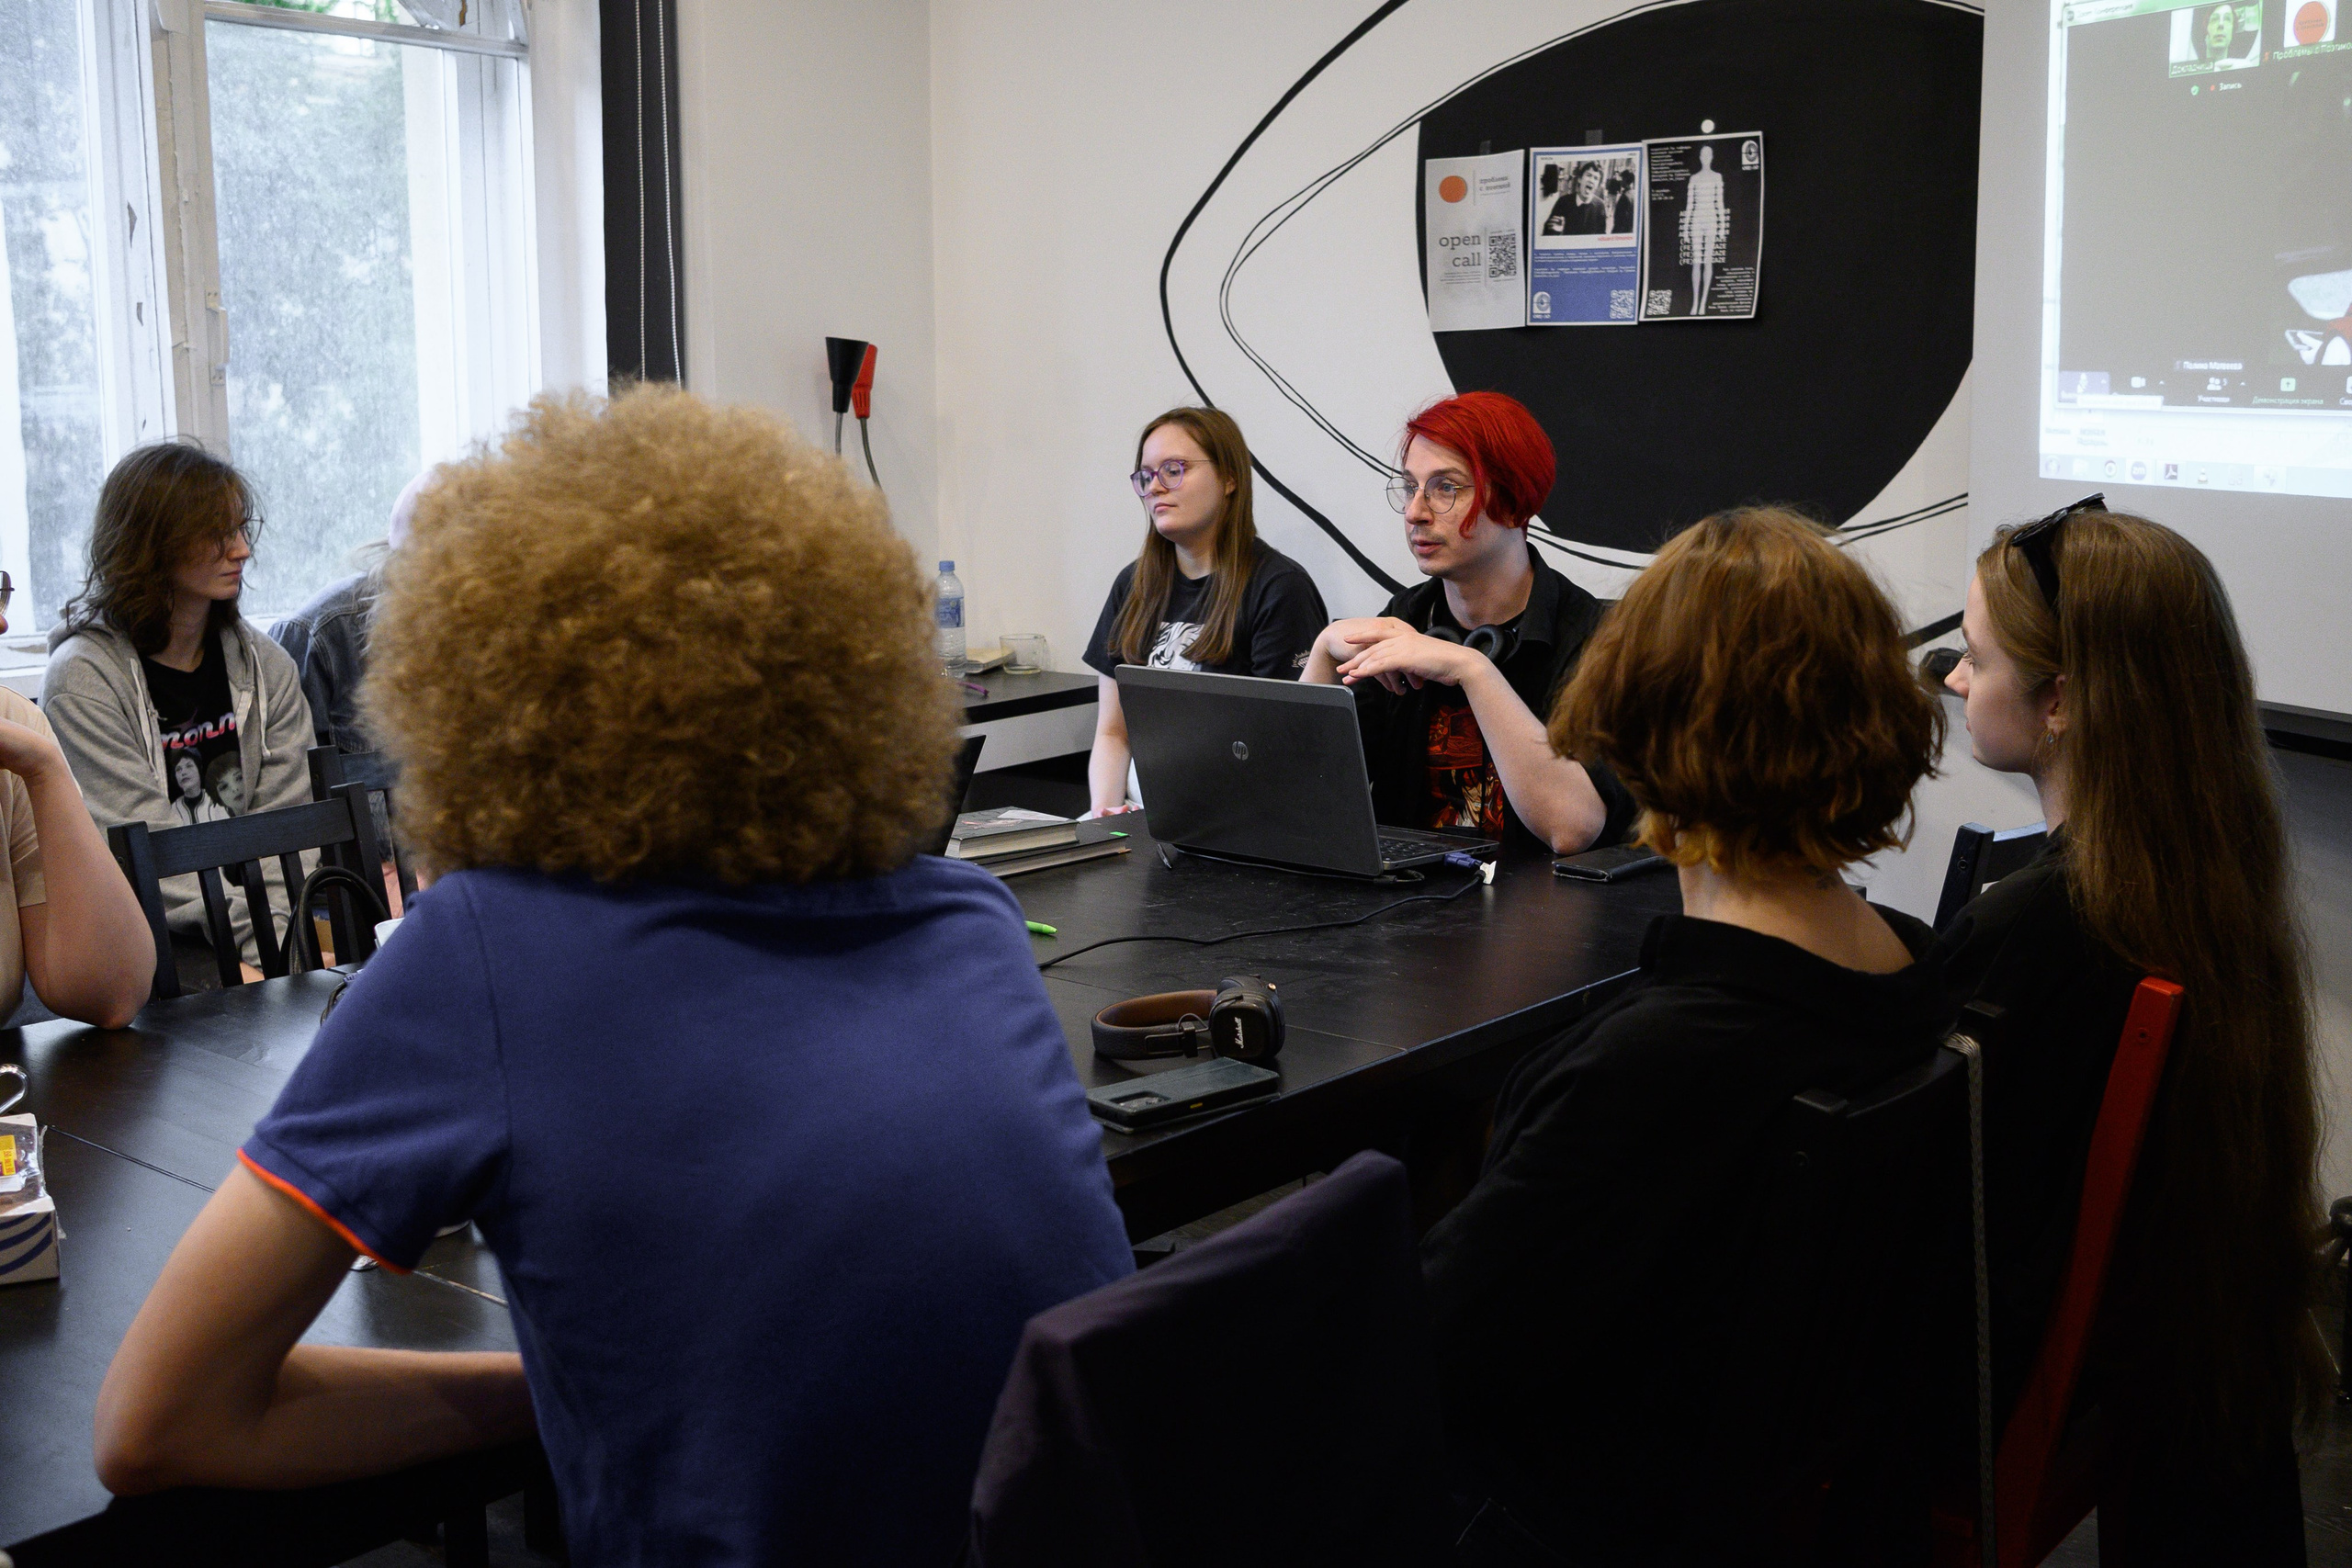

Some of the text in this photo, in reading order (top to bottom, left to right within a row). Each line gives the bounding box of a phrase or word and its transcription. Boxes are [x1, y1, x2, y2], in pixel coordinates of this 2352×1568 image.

[2321, 42, 2352, 53] Поэтико
[2219, 82, 2242, 92] Запись
[1439, 234, 1481, 250] open
[1452, 253, 1481, 267] call
[1234, 741, 1248, 761] hp
